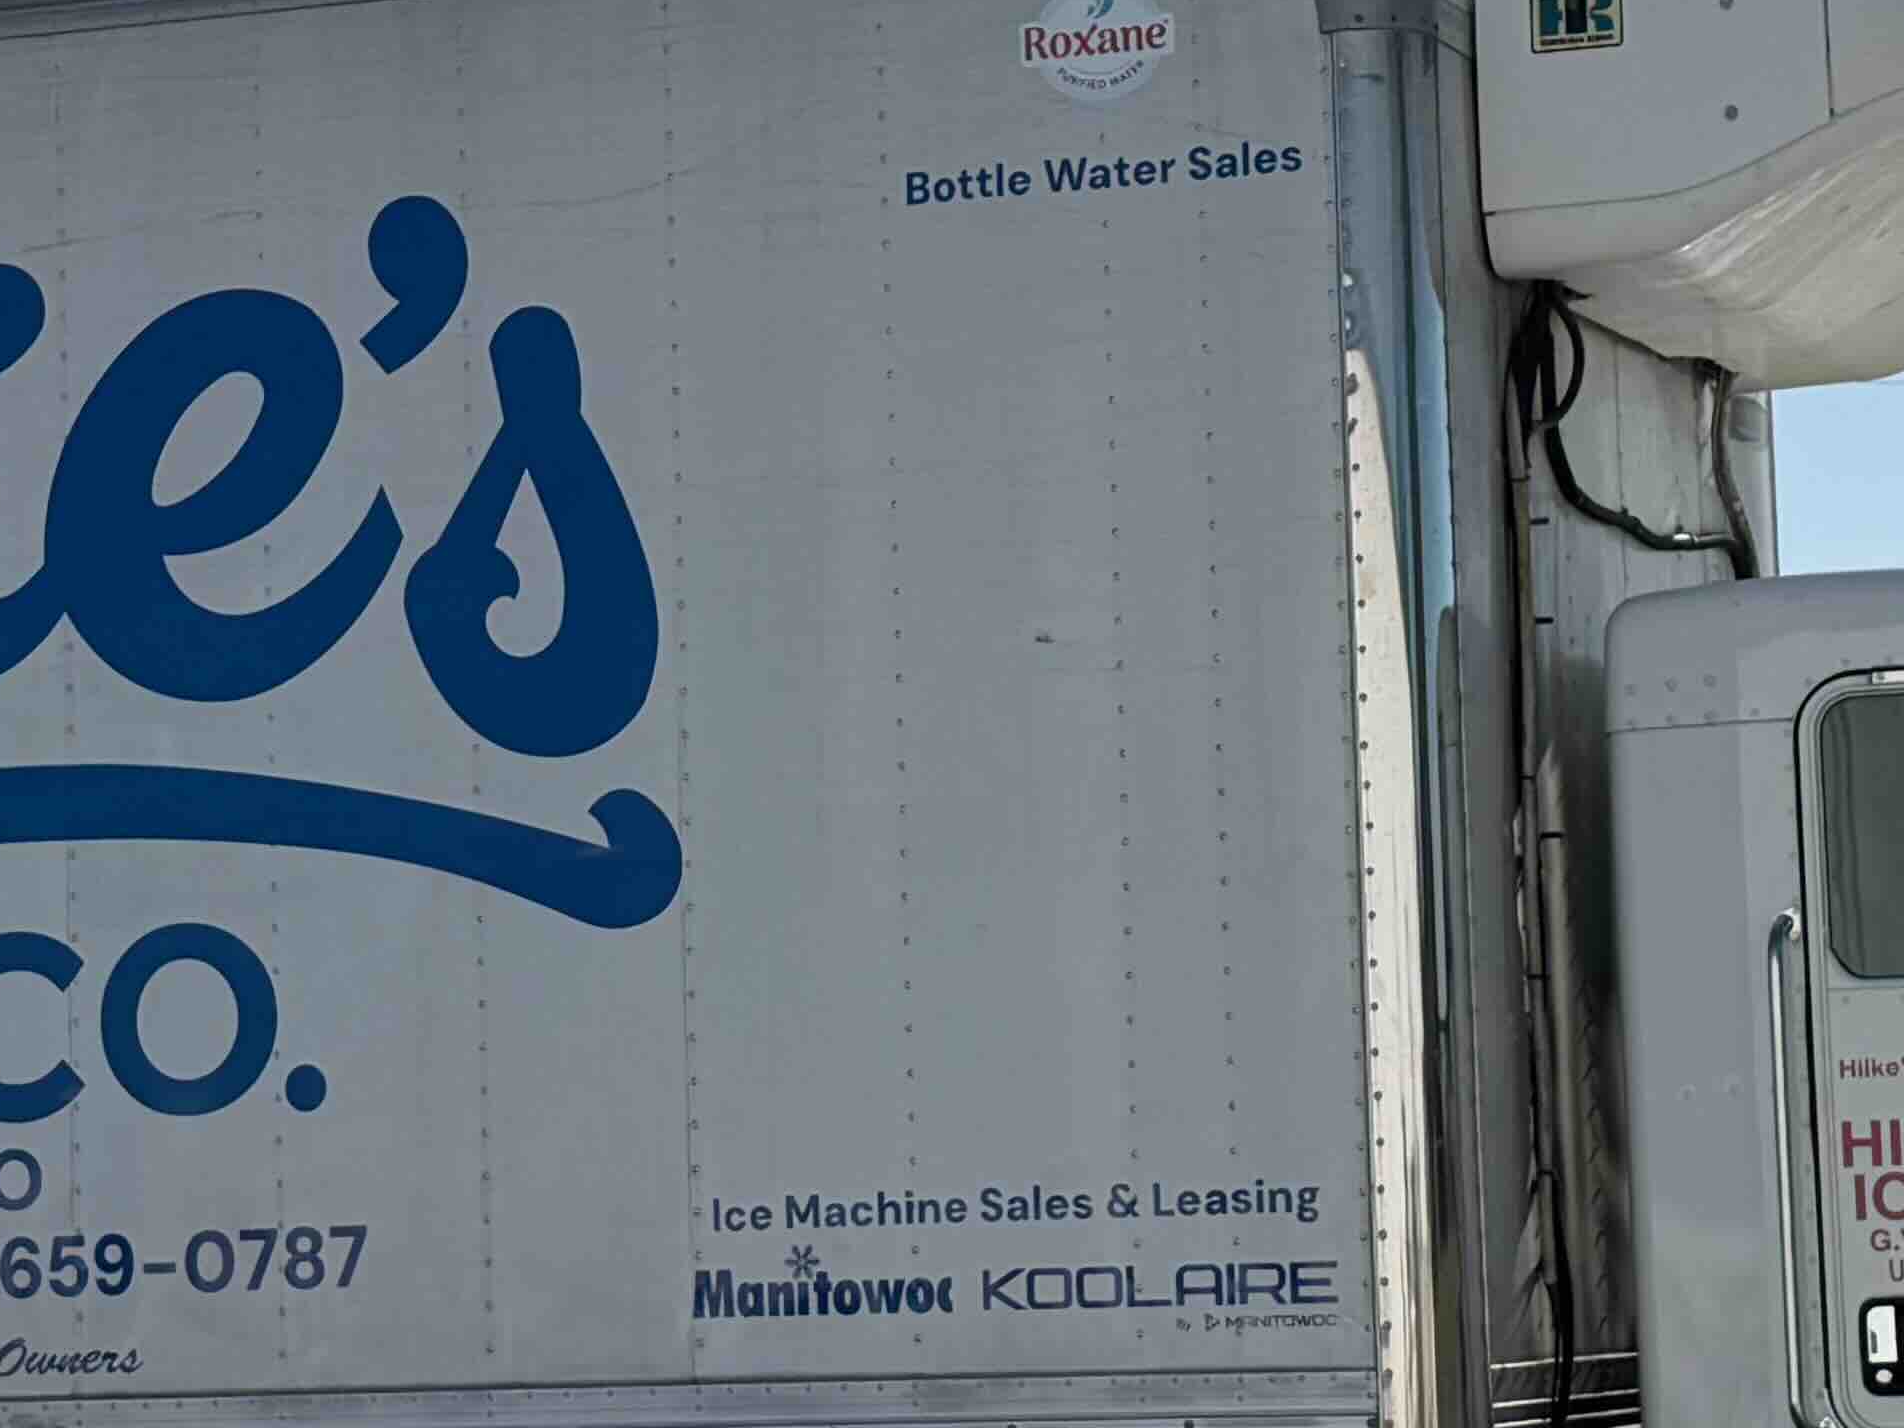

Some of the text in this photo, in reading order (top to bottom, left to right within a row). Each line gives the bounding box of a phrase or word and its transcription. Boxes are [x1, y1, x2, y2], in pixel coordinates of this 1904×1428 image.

[1024, 22, 1167, 61] Roxane
[905, 142, 1303, 205] Bottle Water Sales
[713, 1179, 1319, 1232] Ice Machine Sales & Leasing
[693, 1268, 953, 1319] Manitowoc
[983, 1260, 1338, 1310] KOOLAIRE
